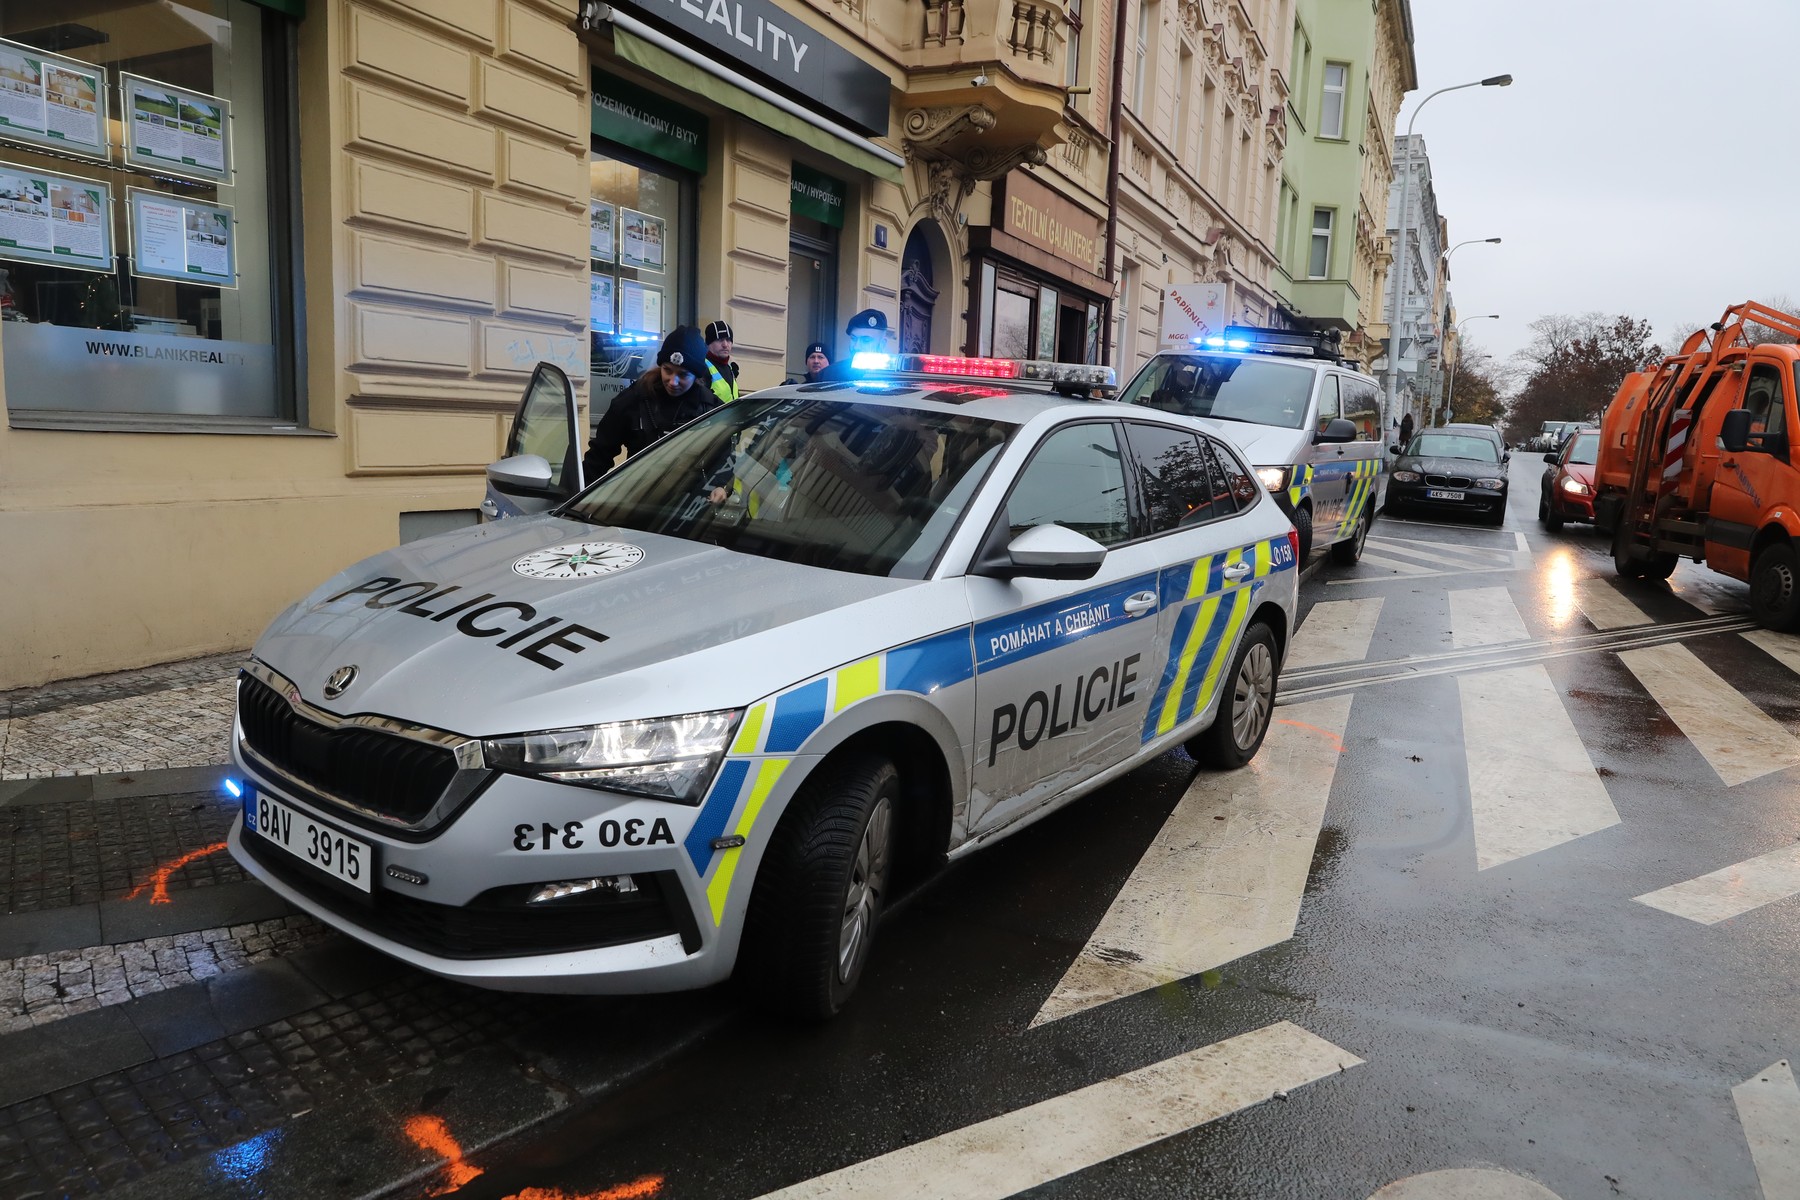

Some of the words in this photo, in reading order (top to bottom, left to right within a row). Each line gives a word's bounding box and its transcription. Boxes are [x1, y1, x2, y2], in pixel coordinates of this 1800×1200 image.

[664, 0, 809, 74] ALITY
[643, 113, 670, 134] DOMY
[676, 126, 698, 145] BYTY
[1011, 195, 1049, 241] TEXTILNÍ
[1049, 218, 1093, 264] GALANTERIE
[1170, 290, 1213, 337] PAPÍRNICTV
[325, 576, 610, 671] POLICIE
[990, 621, 1050, 656] POMÁHAT
[1055, 619, 1064, 636] A
[1065, 604, 1110, 632] CHRÁNIT
[988, 652, 1141, 768] POLICIE
[247, 813, 256, 825] CZ
[260, 799, 291, 846] 8AV
[307, 824, 360, 880] 3915
